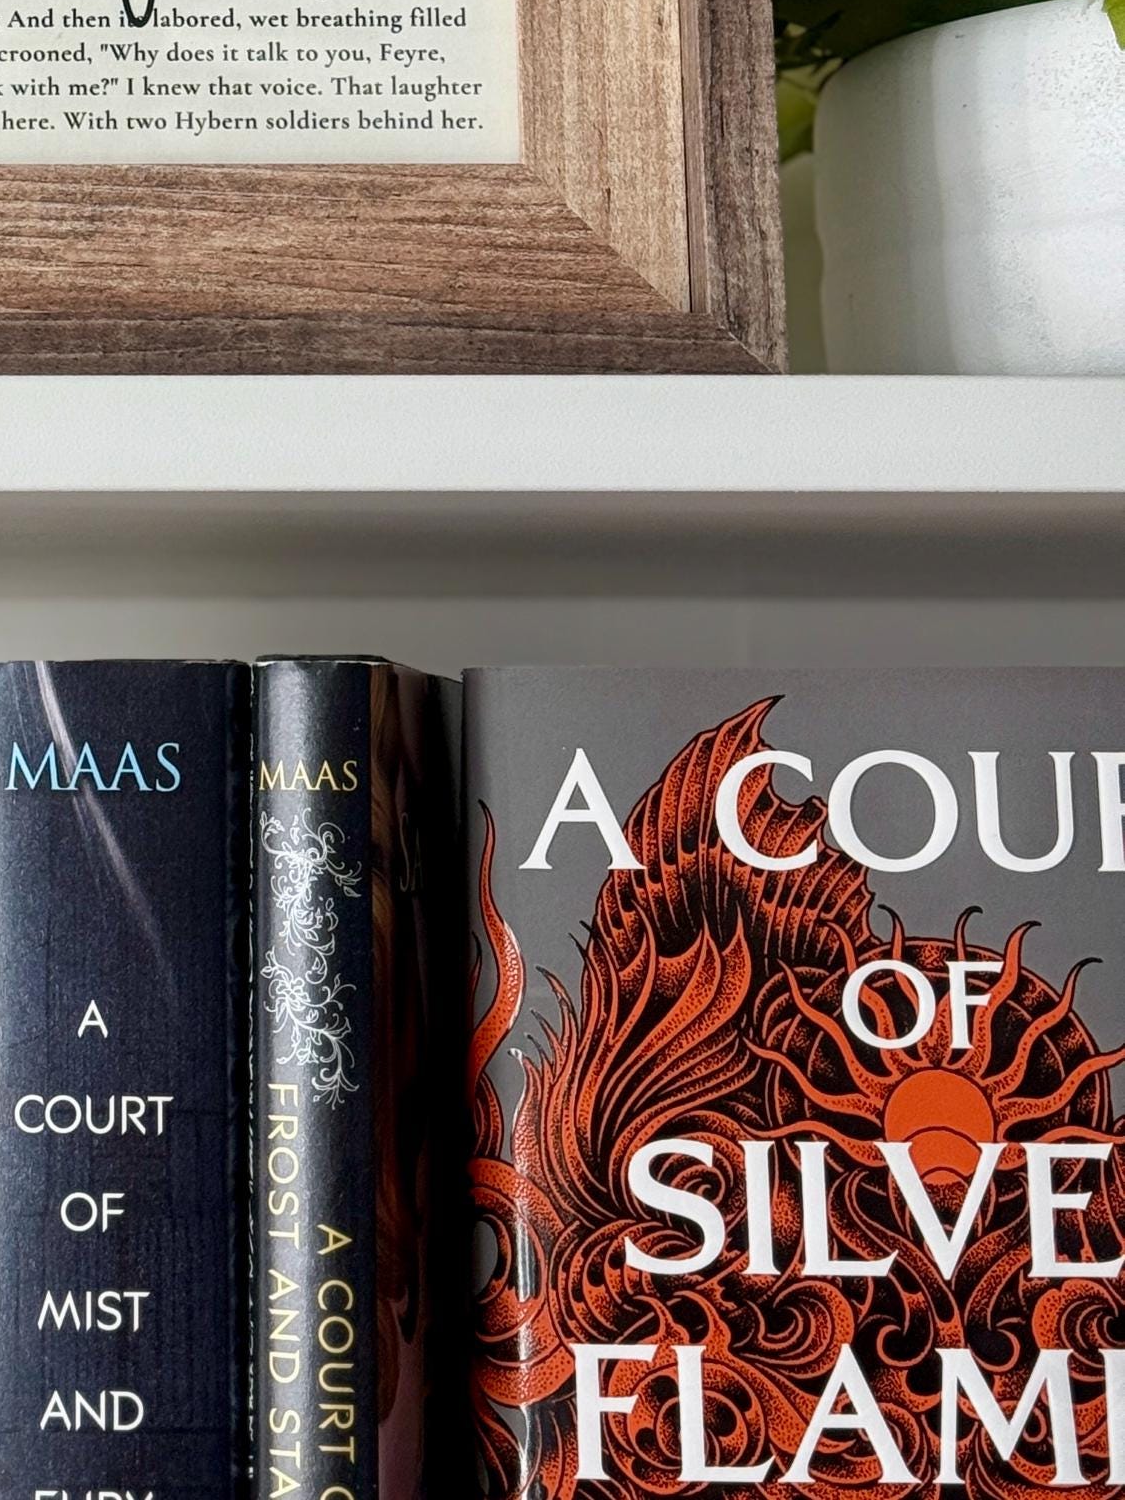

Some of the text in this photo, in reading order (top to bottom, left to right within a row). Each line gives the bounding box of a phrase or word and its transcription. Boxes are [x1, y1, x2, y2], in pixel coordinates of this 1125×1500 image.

[10, 75, 61, 97] with
[68, 77, 119, 96] me?"
[126, 77, 134, 96] I
[142, 75, 201, 96] knew
[208, 75, 253, 96] that
[259, 77, 323, 96] voice.
[330, 75, 383, 96] That
[390, 74, 483, 103] laughter
[1, 109, 56, 131] here.
[63, 109, 118, 130] With
[126, 116, 167, 130] two
[175, 109, 258, 137] Hybern
[265, 109, 350, 130] soldiers
[357, 109, 434, 130] behind
[440, 108, 484, 130] her.
[5, 741, 183, 792] MAAS
[258, 759, 359, 792] MAAS
[518, 747, 647, 870] A
[76, 999, 110, 1039] A
[842, 958, 1003, 1051] OF
[13, 1094, 174, 1137] COURT
[267, 1083, 300, 1251] FROST
[59, 1190, 125, 1233] OF
[316, 1223, 353, 1256] A
[37, 1290, 151, 1334] MIST
[268, 1268, 301, 1385] AND
[317, 1279, 356, 1465] COURT
[39, 1390, 145, 1433] AND
